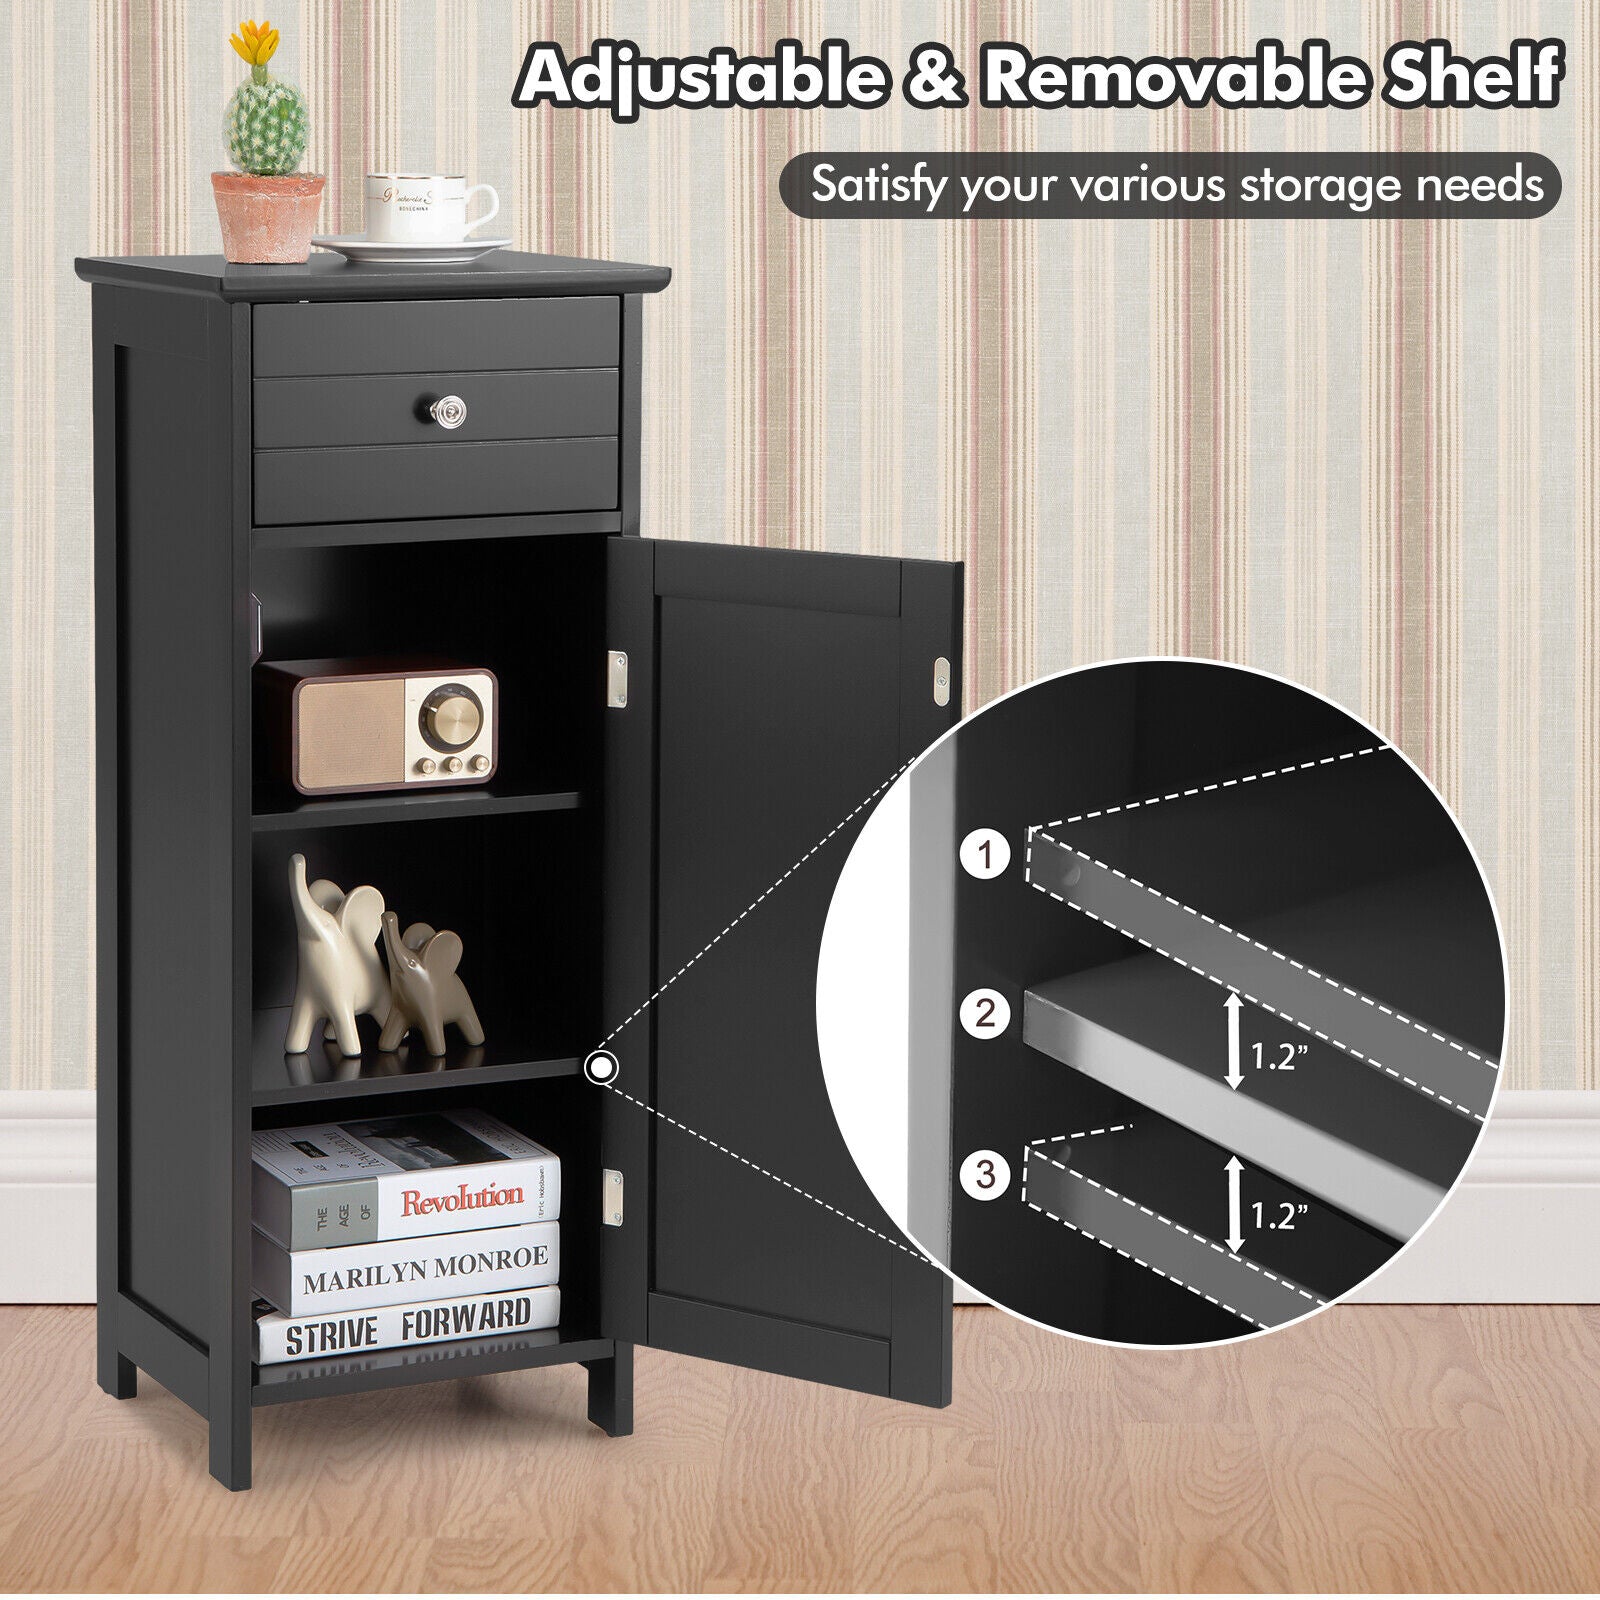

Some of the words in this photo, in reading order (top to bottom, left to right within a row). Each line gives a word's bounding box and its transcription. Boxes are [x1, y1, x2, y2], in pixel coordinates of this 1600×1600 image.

[360, 1204, 371, 1220] OF
[400, 1181, 525, 1217] Revolution
[317, 1207, 328, 1231] THE
[338, 1204, 350, 1228] AGE
[303, 1260, 427, 1295] MARILYN
[434, 1245, 549, 1277] MONROE
[286, 1315, 378, 1356] STRIVE
[402, 1297, 532, 1341] FORWARD
